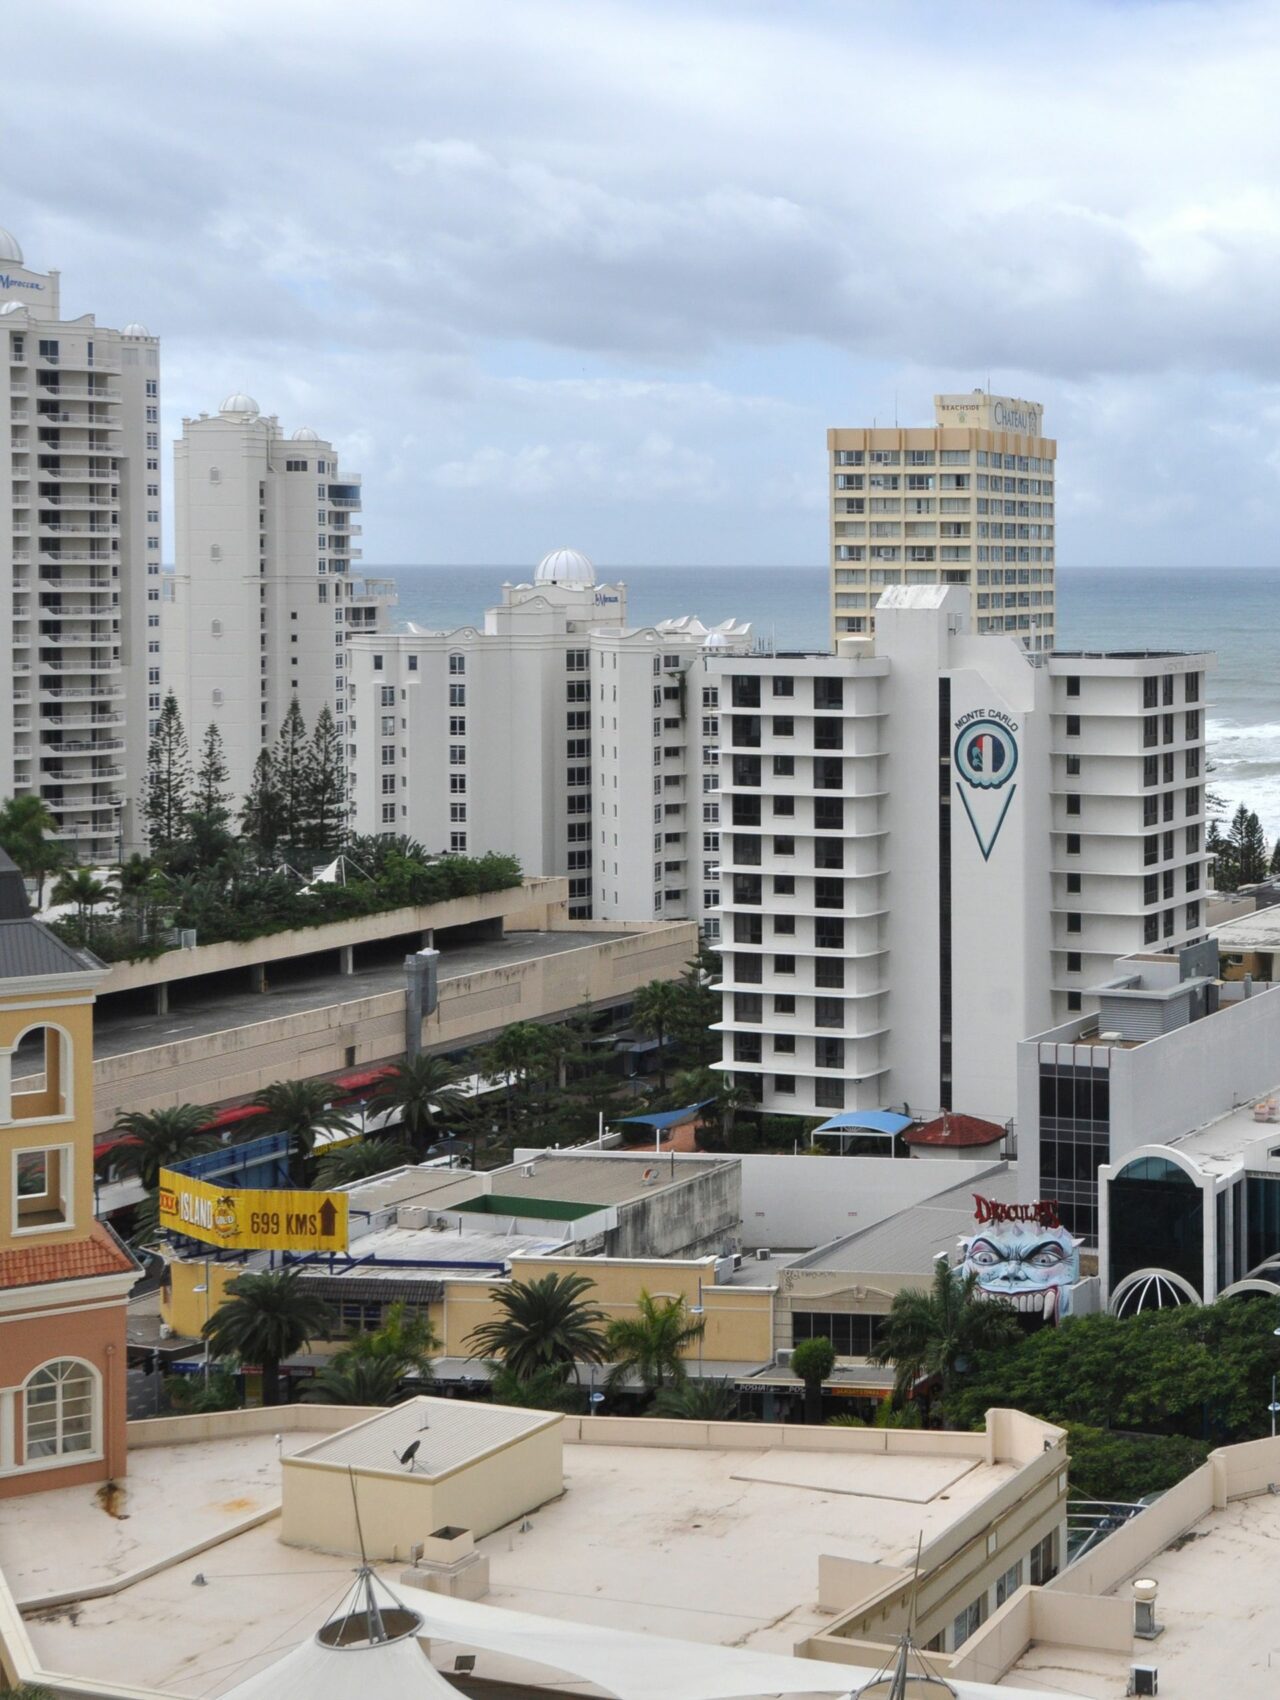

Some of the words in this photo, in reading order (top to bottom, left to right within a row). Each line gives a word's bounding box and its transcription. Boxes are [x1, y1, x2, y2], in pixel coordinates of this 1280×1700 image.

[954, 708, 985, 730] MONTE
[988, 709, 1018, 732] CARLO
[180, 1192, 213, 1229] ISLAND
[250, 1213, 280, 1235] 699
[286, 1213, 318, 1236] KMS
